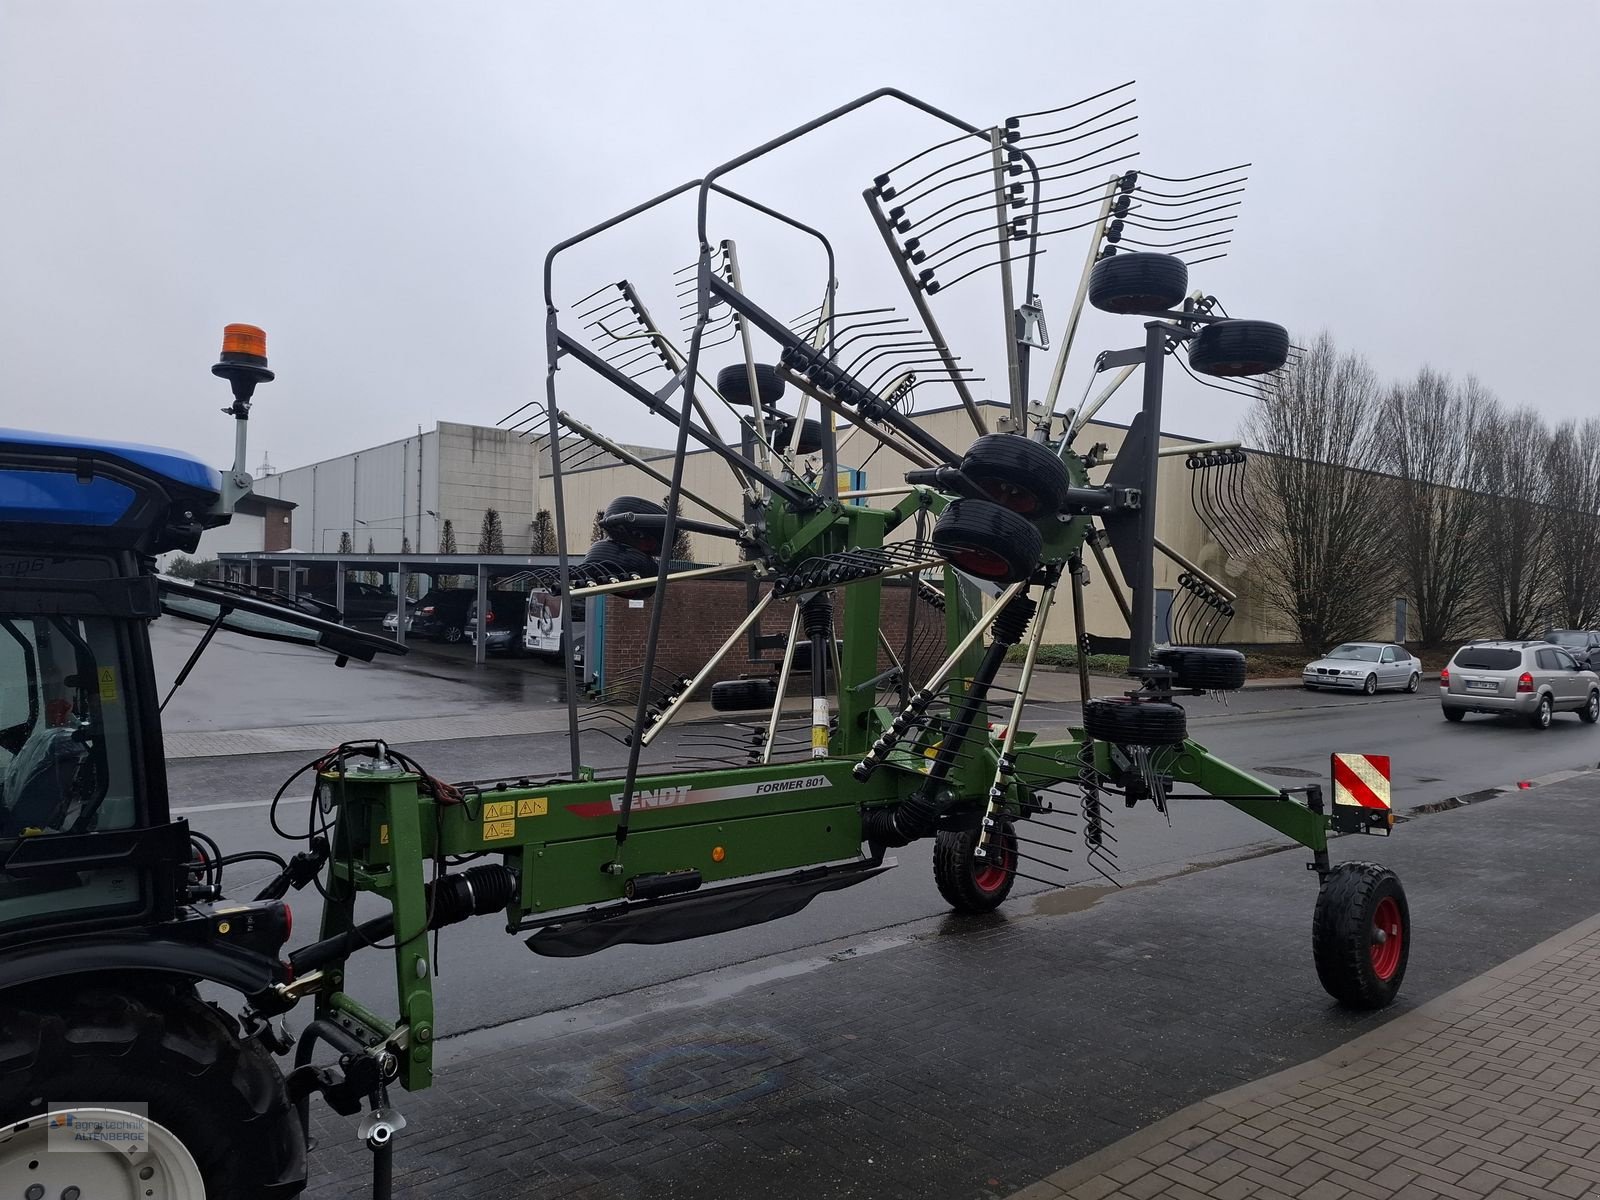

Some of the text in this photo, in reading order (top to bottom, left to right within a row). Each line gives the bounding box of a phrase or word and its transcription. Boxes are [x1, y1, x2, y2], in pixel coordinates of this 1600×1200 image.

[756, 777, 825, 794] FORMER 801
[609, 785, 692, 812] FENDT
